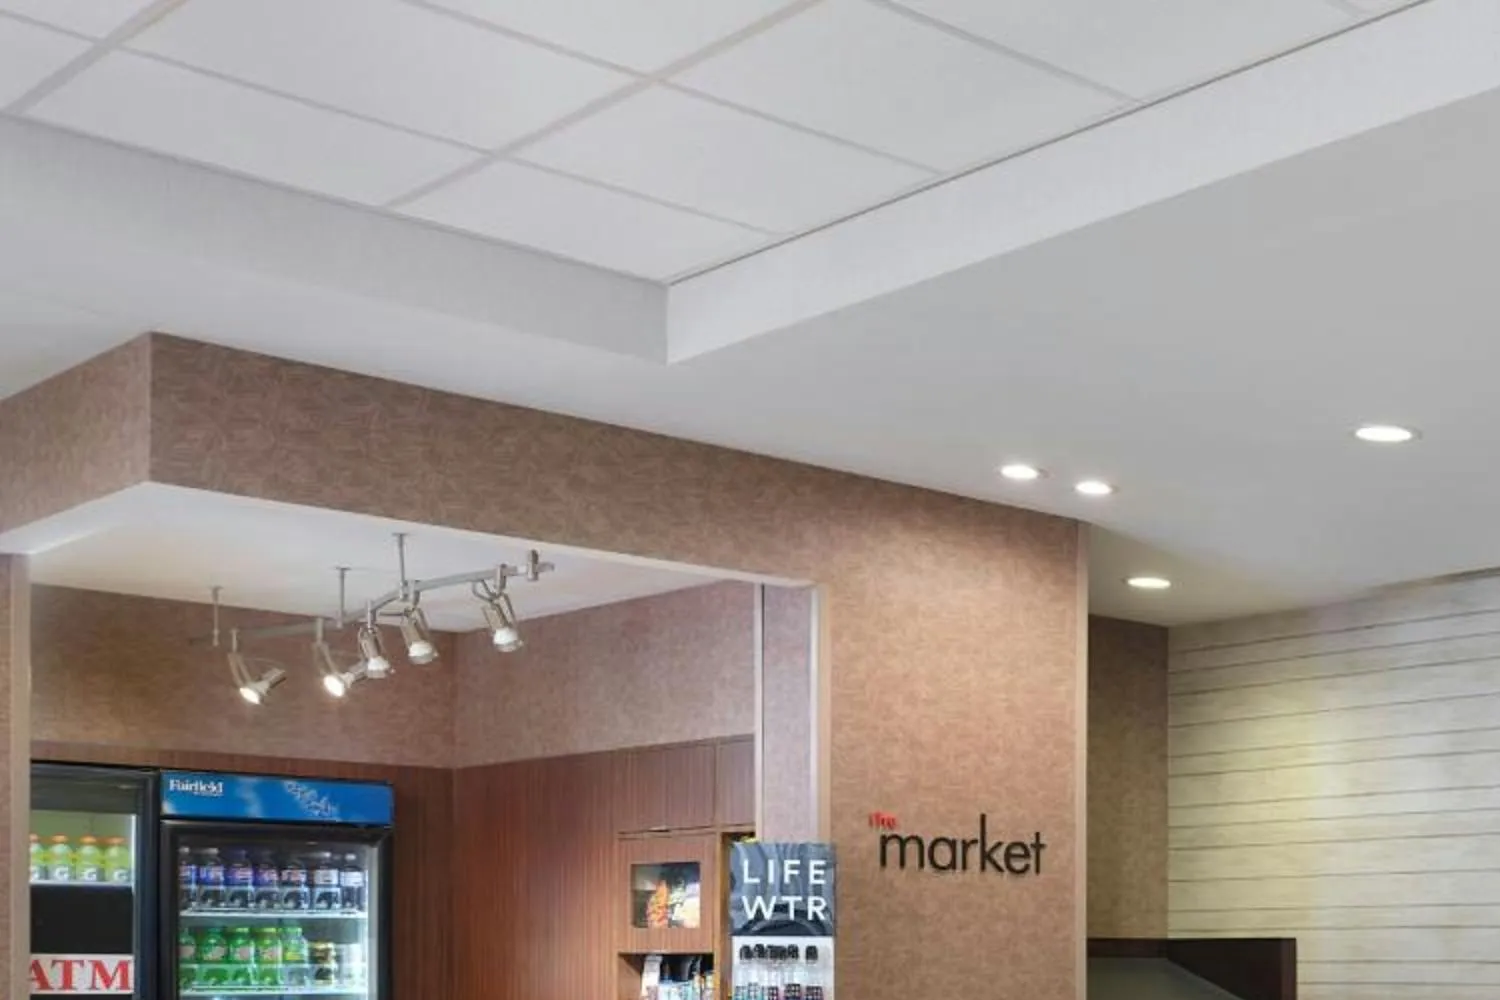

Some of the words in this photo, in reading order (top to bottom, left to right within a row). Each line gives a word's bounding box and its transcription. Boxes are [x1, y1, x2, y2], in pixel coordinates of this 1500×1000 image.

[169, 779, 224, 793] Fairfield
[879, 813, 1047, 875] market
[743, 859, 826, 884] LIFE
[742, 895, 827, 921] WTR
[30, 959, 131, 990] ATM
